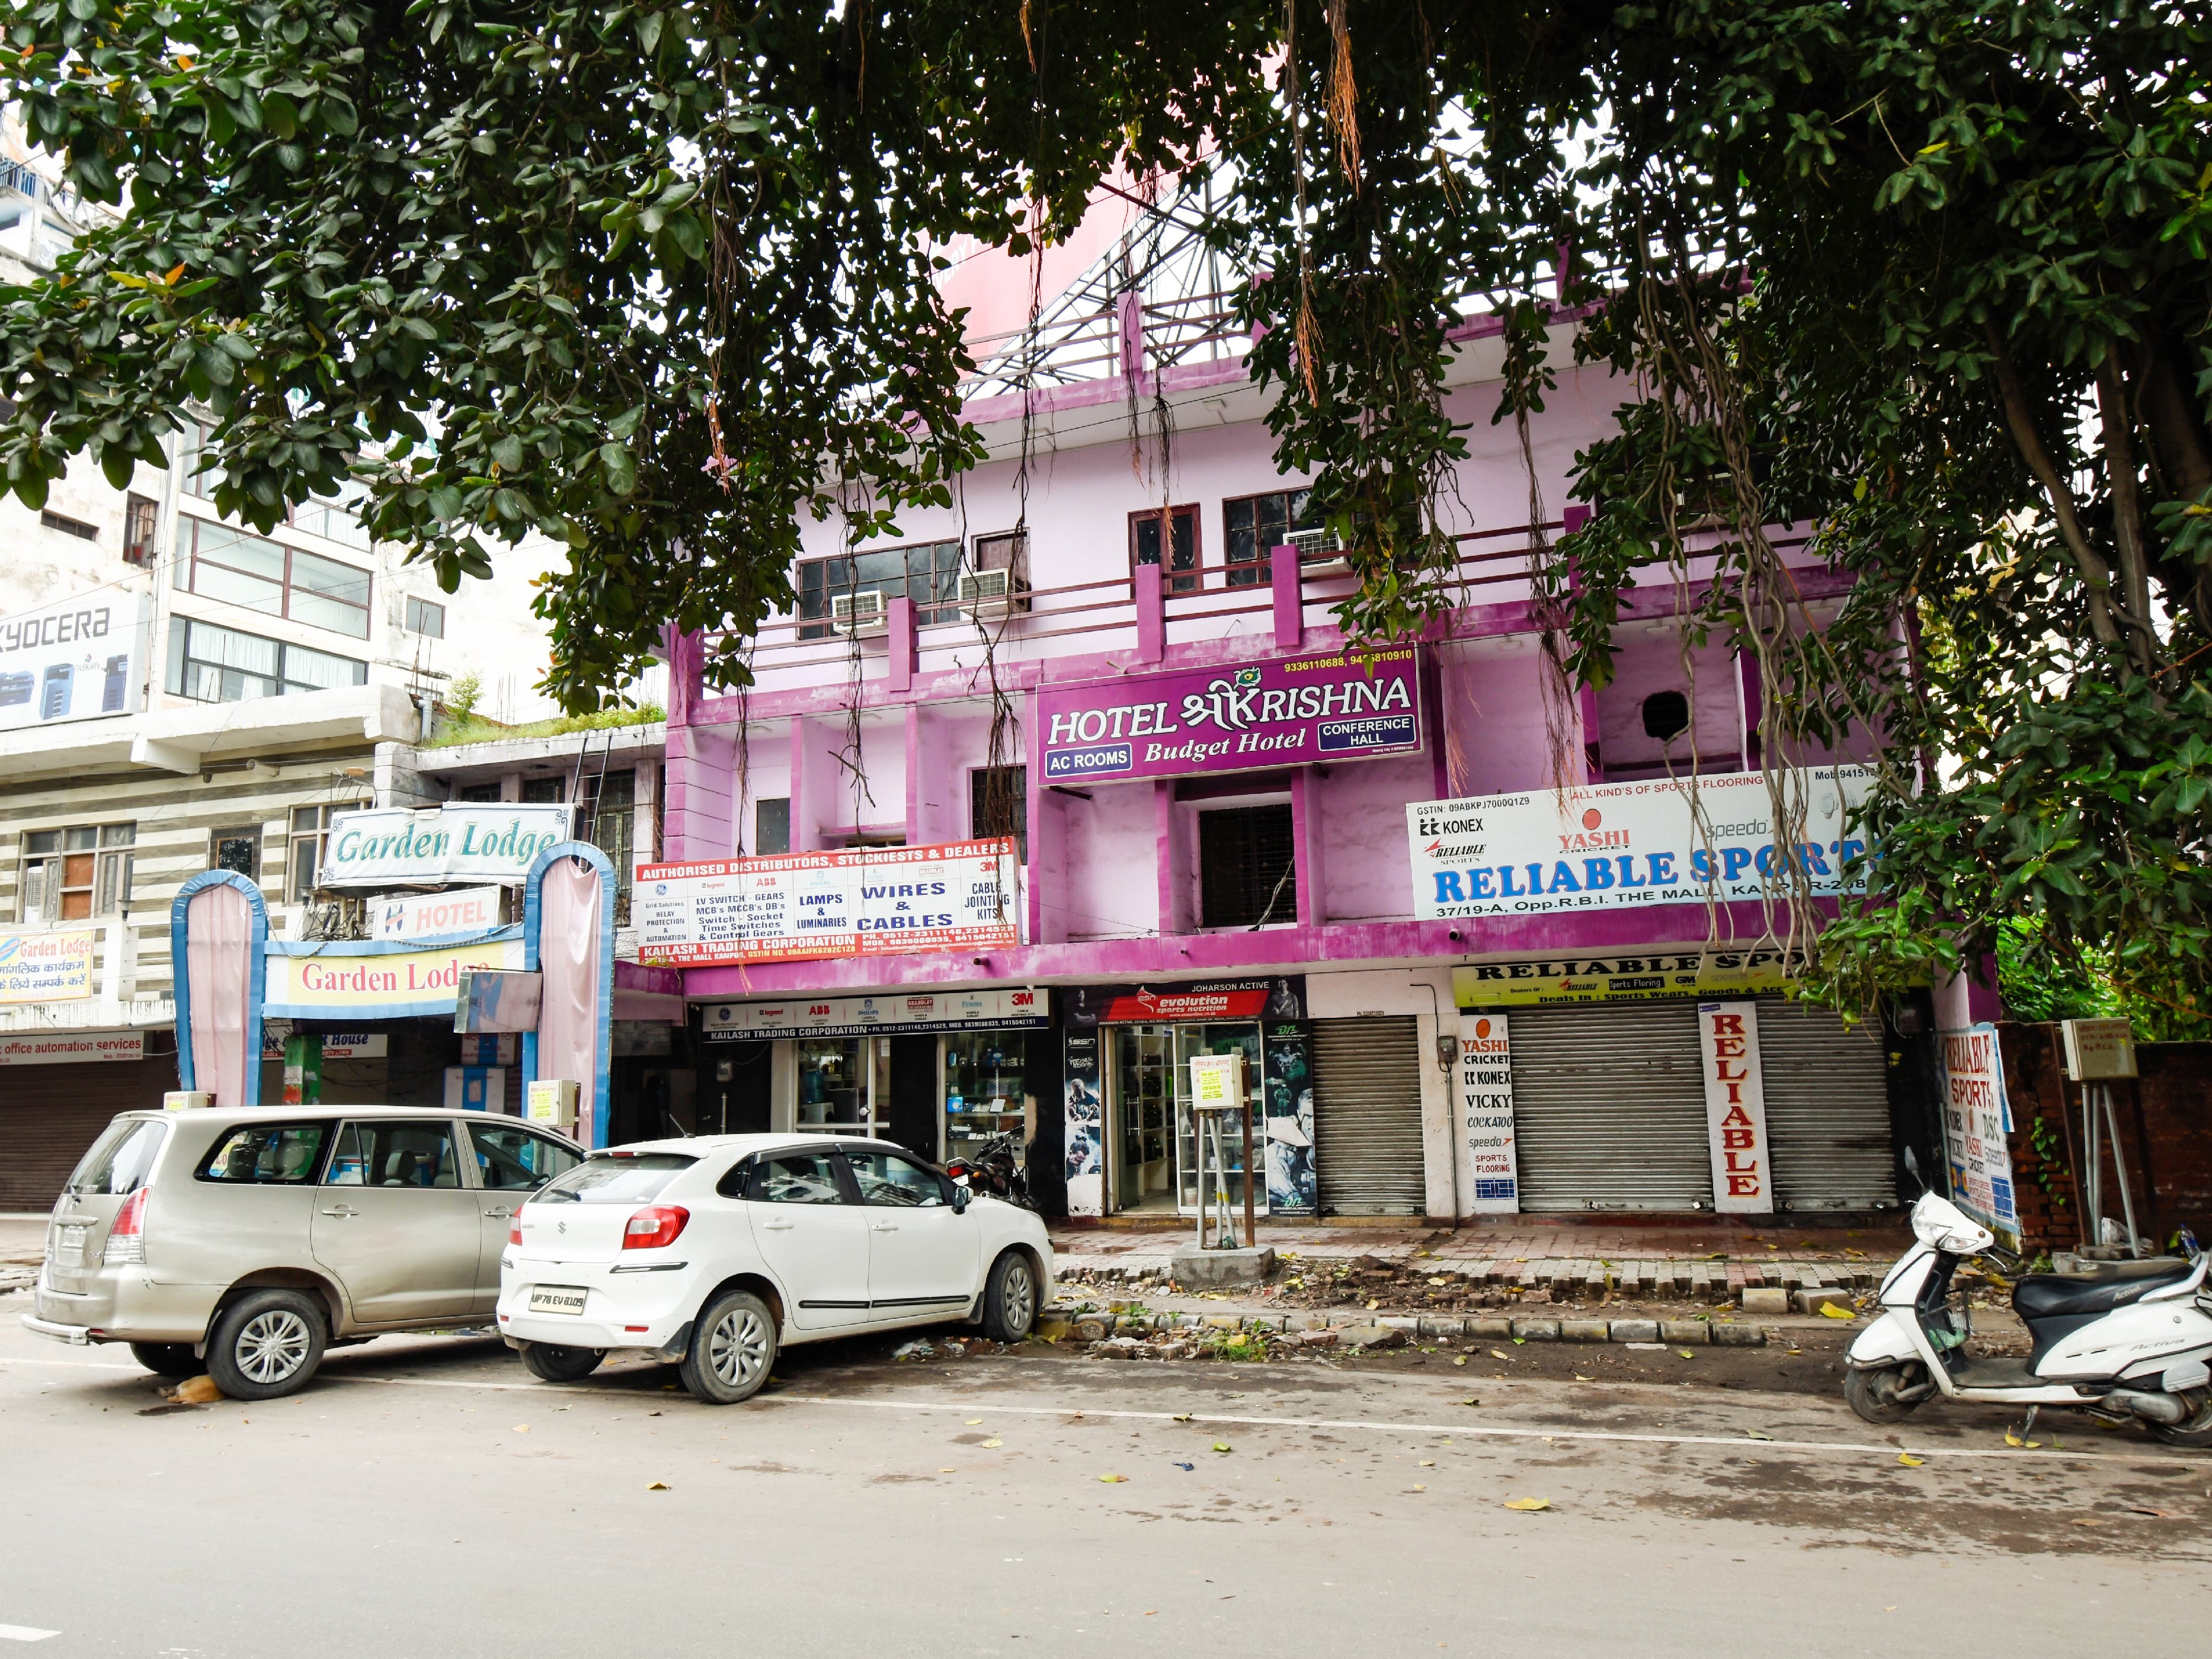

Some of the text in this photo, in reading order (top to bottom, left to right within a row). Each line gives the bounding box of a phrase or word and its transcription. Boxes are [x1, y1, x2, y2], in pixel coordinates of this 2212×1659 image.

[1229, 677, 1411, 725] KRISHNA
[1048, 702, 1177, 745] HOTEL
[1323, 718, 1410, 736] CONFERENCE
[1143, 728, 1306, 762] Budget Hotel
[1350, 734, 1384, 745] HALL
[1051, 750, 1128, 770] AC ROOMS
[1571, 776, 1763, 800] ALL KIND'S OF SPORTS FLOORING
[1417, 806, 1446, 815] GSTIN:
[1443, 818, 1484, 834] KONEX
[1706, 819, 1766, 841] speedo
[335, 818, 557, 867] Garden Lodge
[1557, 830, 1631, 850] YASHI
[1434, 844, 1486, 858] RELIABLE
[1559, 845, 1631, 854] CRICKET
[642, 842, 1009, 879] AUTHORISED DISTRIBUTORS, STOCKIESTS & DEALERS
[980, 861, 998, 872] 3M
[1440, 857, 1480, 865] SPORTS
[1433, 839, 1885, 903] RELIABLE SPORT
[756, 877, 776, 887] ABB
[860, 882, 946, 899] WIRES
[709, 895, 744, 904] SWITCH
[755, 892, 785, 901] GEARS
[799, 894, 843, 906] LAMPS
[1437, 904, 1508, 917] 37/19-A,
[1615, 891, 1656, 902] THE
[1662, 888, 1718, 899] MALL
[696, 907, 724, 915] MCB's
[817, 907, 825, 916] &
[895, 901, 911, 910] &
[416, 900, 487, 932] HOTEL
[699, 912, 784, 924] Switch Socket
[977, 908, 998, 920] KITS
[702, 921, 780, 933] Time Switches
[797, 917, 847, 929] LUMINARIES
[857, 914, 953, 931] CABLES
[646, 934, 686, 942] AUTOMATION
[710, 931, 749, 940] Control
[753, 929, 785, 937] Gears
[20, 941, 57, 957] Garden
[60, 938, 90, 957] Lodge
[644, 934, 855, 956] KAILASH TRADING CORPORATION
[44, 960, 85, 973] कार्यक्रम
[1475, 956, 1701, 980] RELIABLE
[302, 963, 399, 991] Garden
[1609, 978, 1661, 989] Sports Floring
[1192, 981, 1269, 992] JOHARSON ACTIVE
[1566, 983, 1598, 992] RELIABLE
[1011, 993, 1033, 1005] 3M
[1160, 995, 1228, 1007] evolution
[1539, 995, 1574, 1003] Deals
[1605, 991, 1645, 1000] Sports
[1650, 990, 1693, 998] Wears,
[809, 1005, 830, 1015] ABB
[331, 1033, 369, 1046] House
[711, 1031, 750, 1040] KAILASH
[753, 1029, 795, 1038] TRADING
[799, 1026, 867, 1036] CORPORATION
[5, 1039, 142, 1054] office automation services
[1462, 1040, 1508, 1053] YASHI
[1464, 1055, 1509, 1064] CRICKET
[1477, 1071, 1511, 1085] KONEX
[1951, 1078, 1994, 1110] SPORTS
[1465, 1094, 1512, 1108] VICKY
[1711, 1014, 1759, 1198] RELIABLE
[1467, 1116, 1513, 1128] COCKATOO
[1983, 1113, 2000, 1143] DSC
[1469, 1138, 1502, 1149] speedo
[1965, 1135, 1983, 1158] YASHI
[1477, 1164, 1510, 1173] FLOORING
[2112, 1285, 2141, 1302] Activa
[2130, 1338, 2185, 1351] Activa
